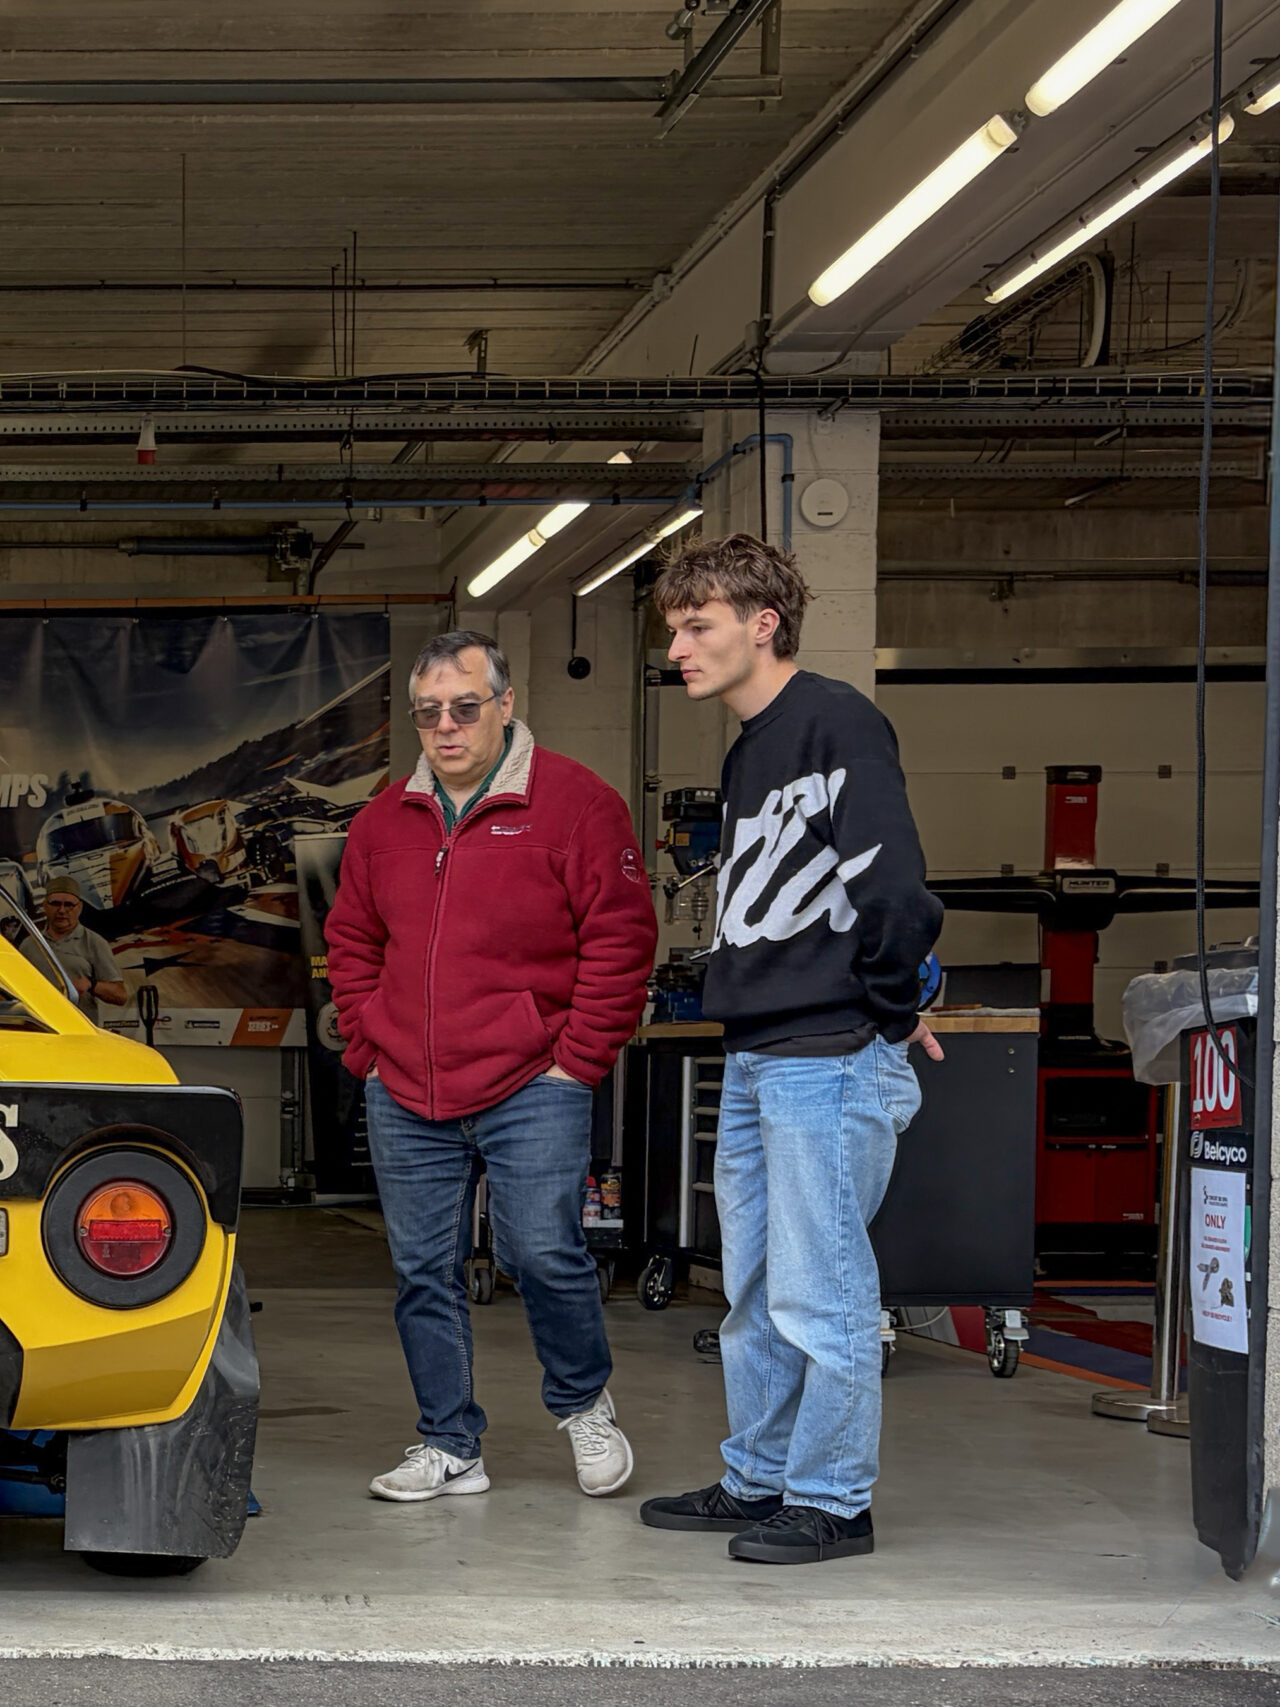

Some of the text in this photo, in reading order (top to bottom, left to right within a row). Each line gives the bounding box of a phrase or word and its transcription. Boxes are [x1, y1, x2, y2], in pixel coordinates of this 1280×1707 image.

[1192, 1029, 1237, 1114] 100
[1204, 1140, 1248, 1166] Belcyco
[1205, 1213, 1227, 1230] ONLY
